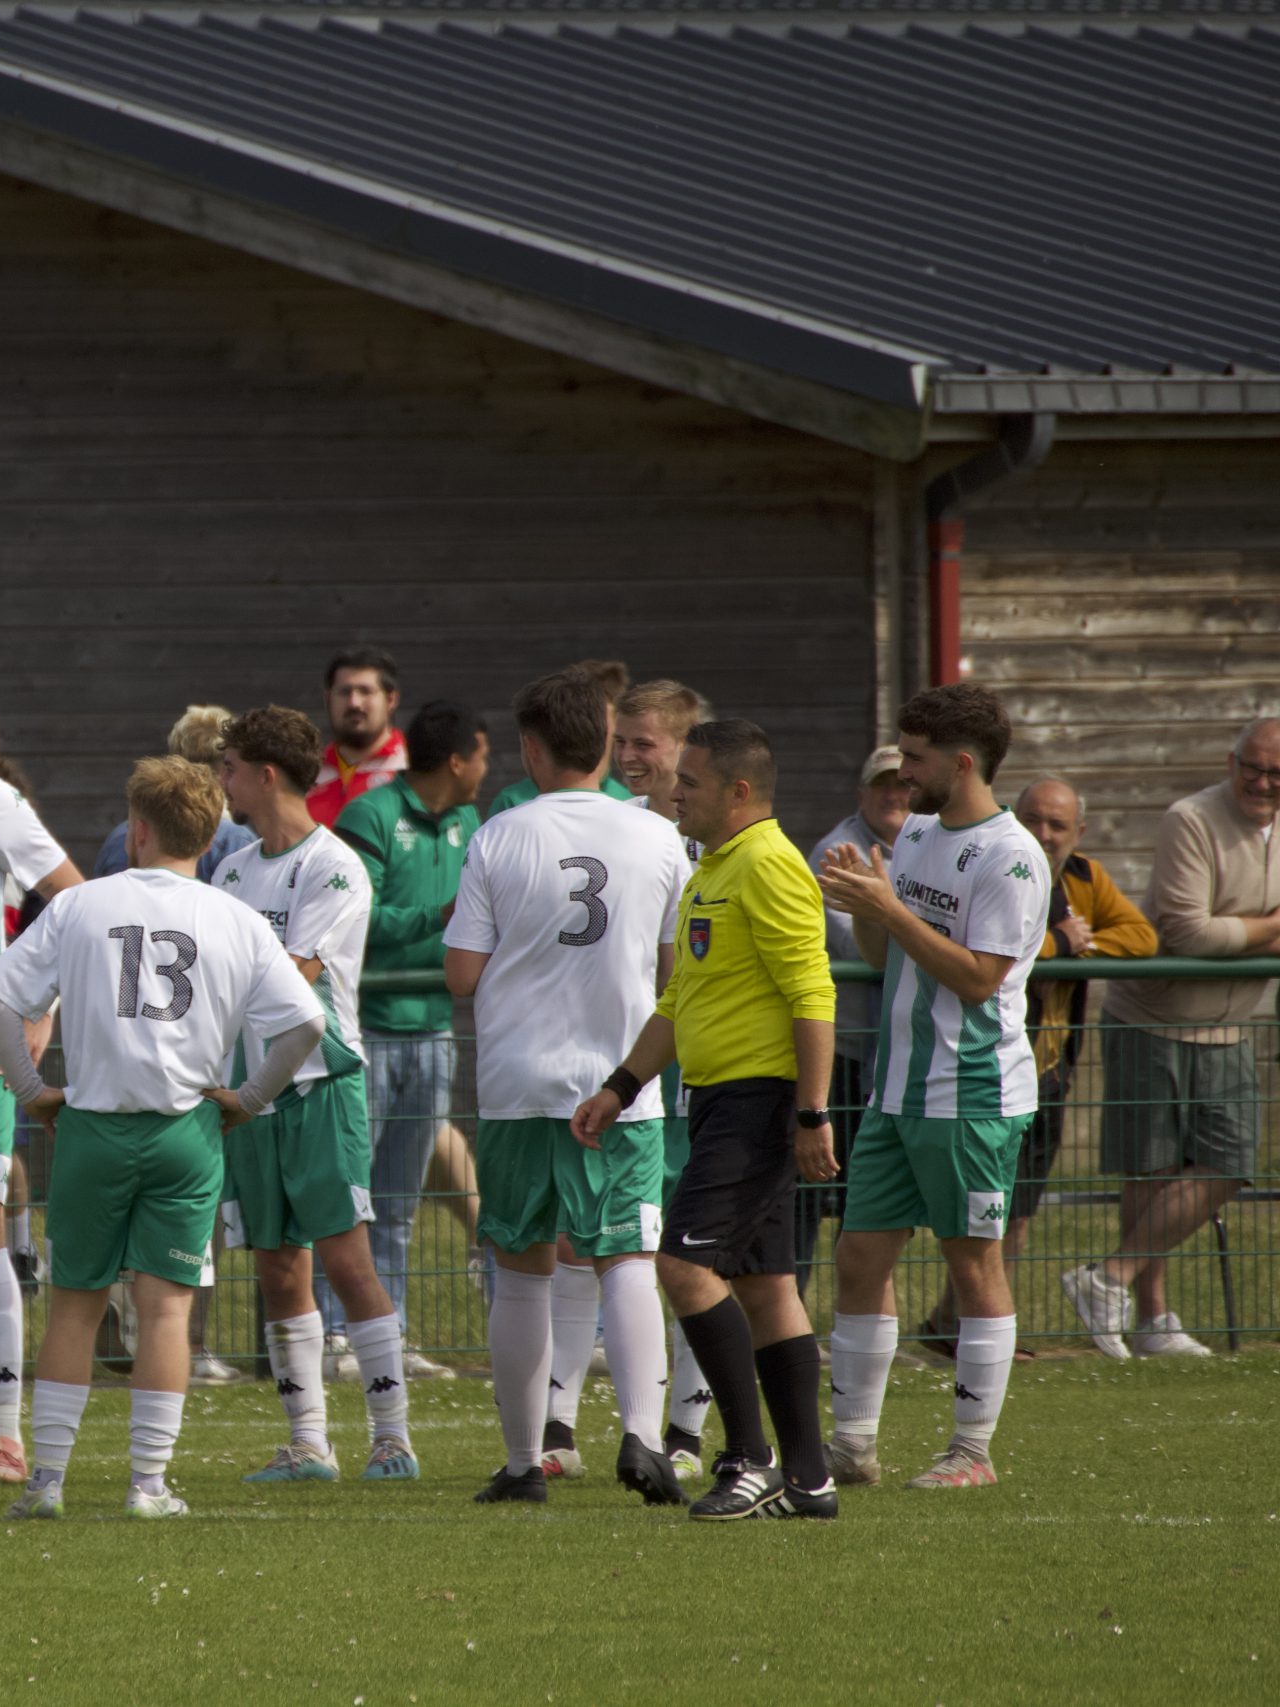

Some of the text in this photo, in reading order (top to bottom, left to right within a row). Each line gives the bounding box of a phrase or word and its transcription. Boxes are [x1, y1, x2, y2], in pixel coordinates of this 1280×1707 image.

[558, 856, 608, 946] 3
[904, 880, 959, 914] UNITECH
[108, 925, 198, 1022] 13
